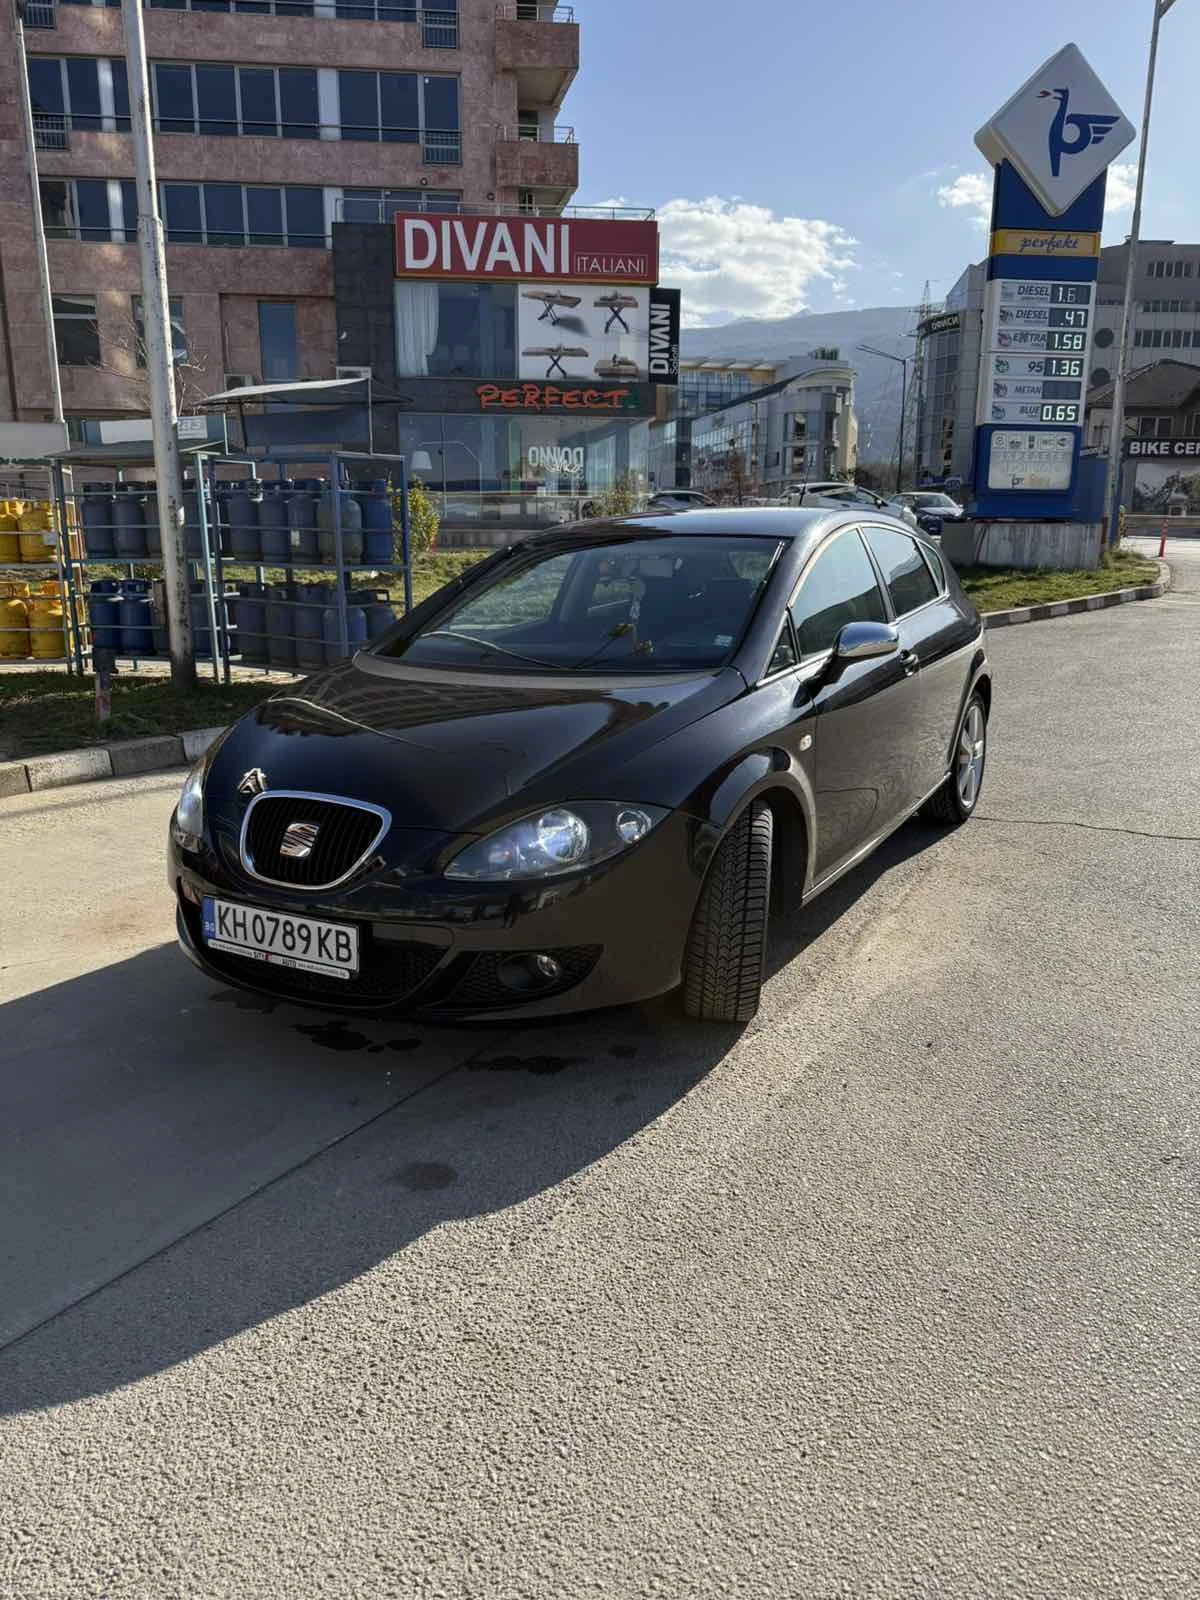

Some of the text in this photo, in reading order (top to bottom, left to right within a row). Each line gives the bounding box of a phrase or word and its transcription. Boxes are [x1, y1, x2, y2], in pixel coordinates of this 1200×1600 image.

[403, 219, 570, 274] DIVANI
[576, 255, 645, 275] ITALIANI
[1017, 285, 1049, 297] DIESEL
[1016, 309, 1048, 320] DIESEL
[649, 303, 671, 374] DIVANI
[1054, 333, 1082, 349] 1.58
[1027, 360, 1044, 373] 95
[1052, 359, 1081, 376] 1.36
[476, 383, 629, 412] PERFECT
[1042, 405, 1076, 421] 0.65
[1129, 441, 1170, 455] BIKE
